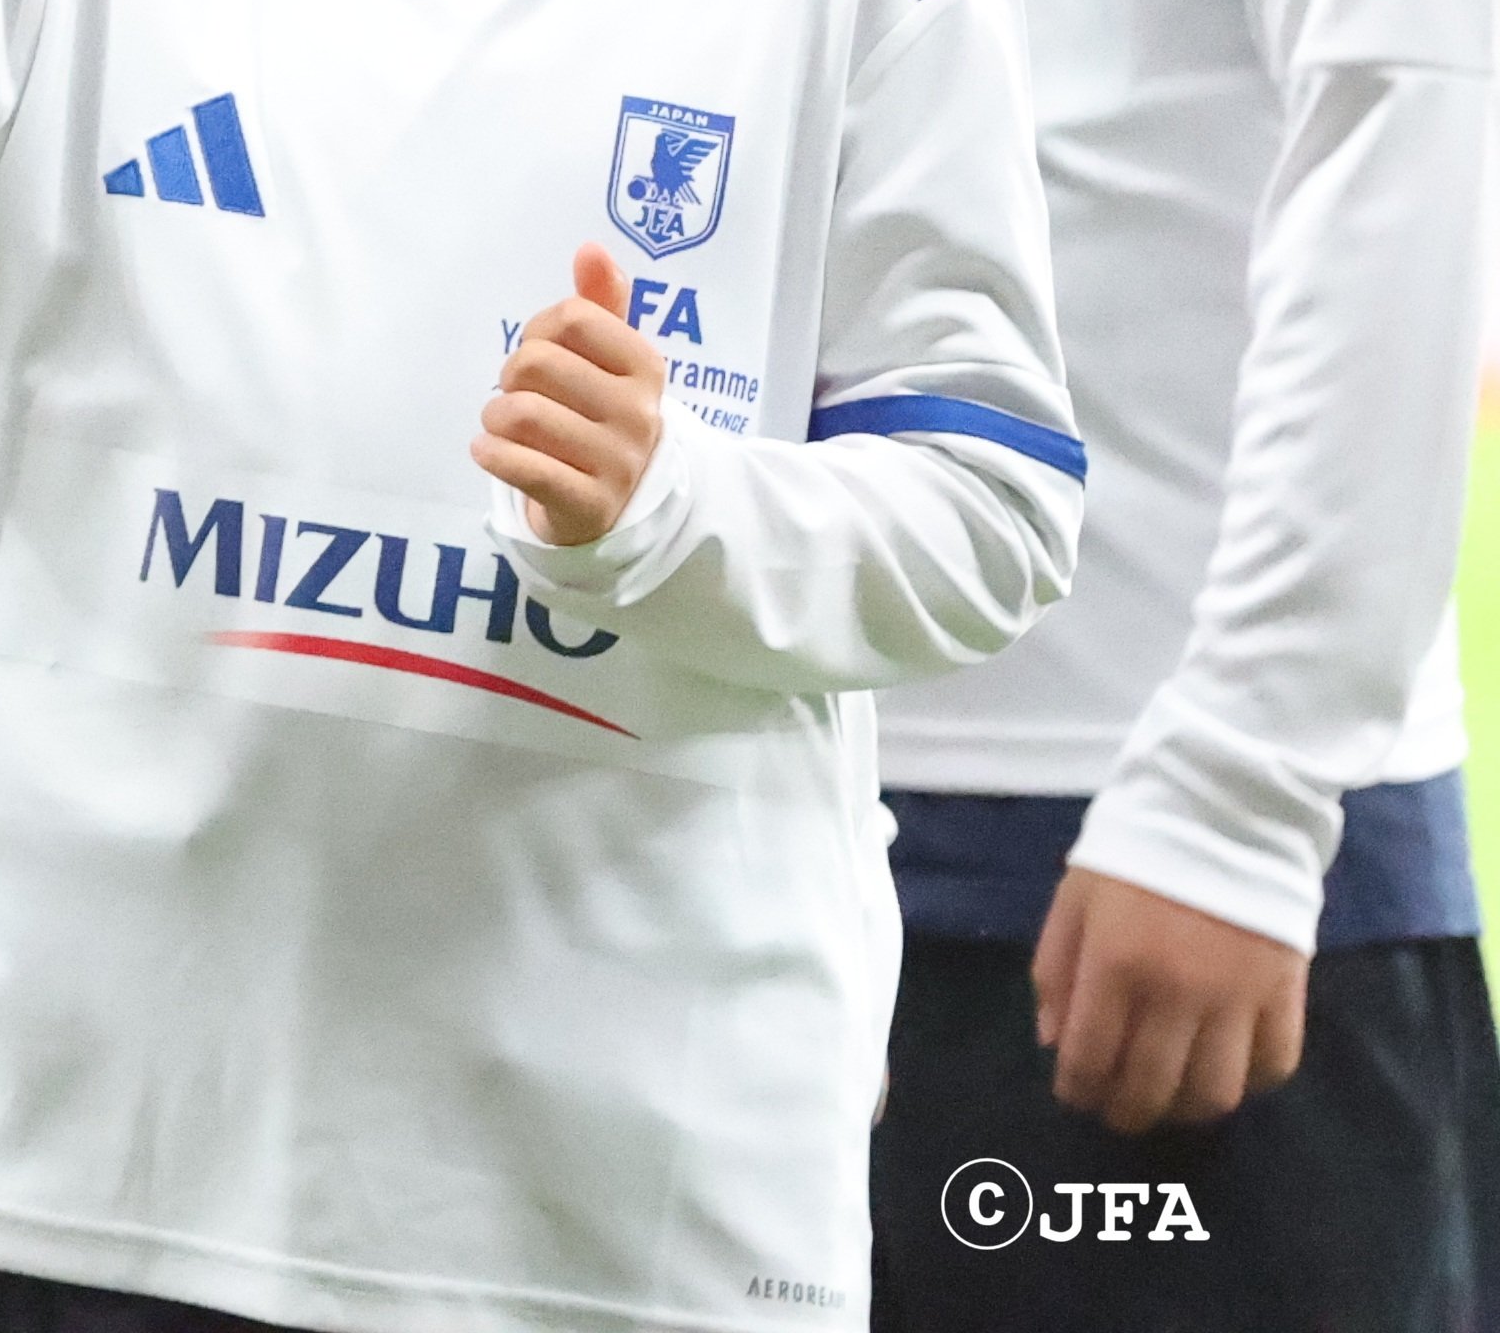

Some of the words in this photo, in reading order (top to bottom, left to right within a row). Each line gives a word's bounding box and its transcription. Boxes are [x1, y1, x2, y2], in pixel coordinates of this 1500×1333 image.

[648, 103, 709, 127] JAPAN
[628, 277, 703, 345] FA
[668, 359, 759, 403] ramme
